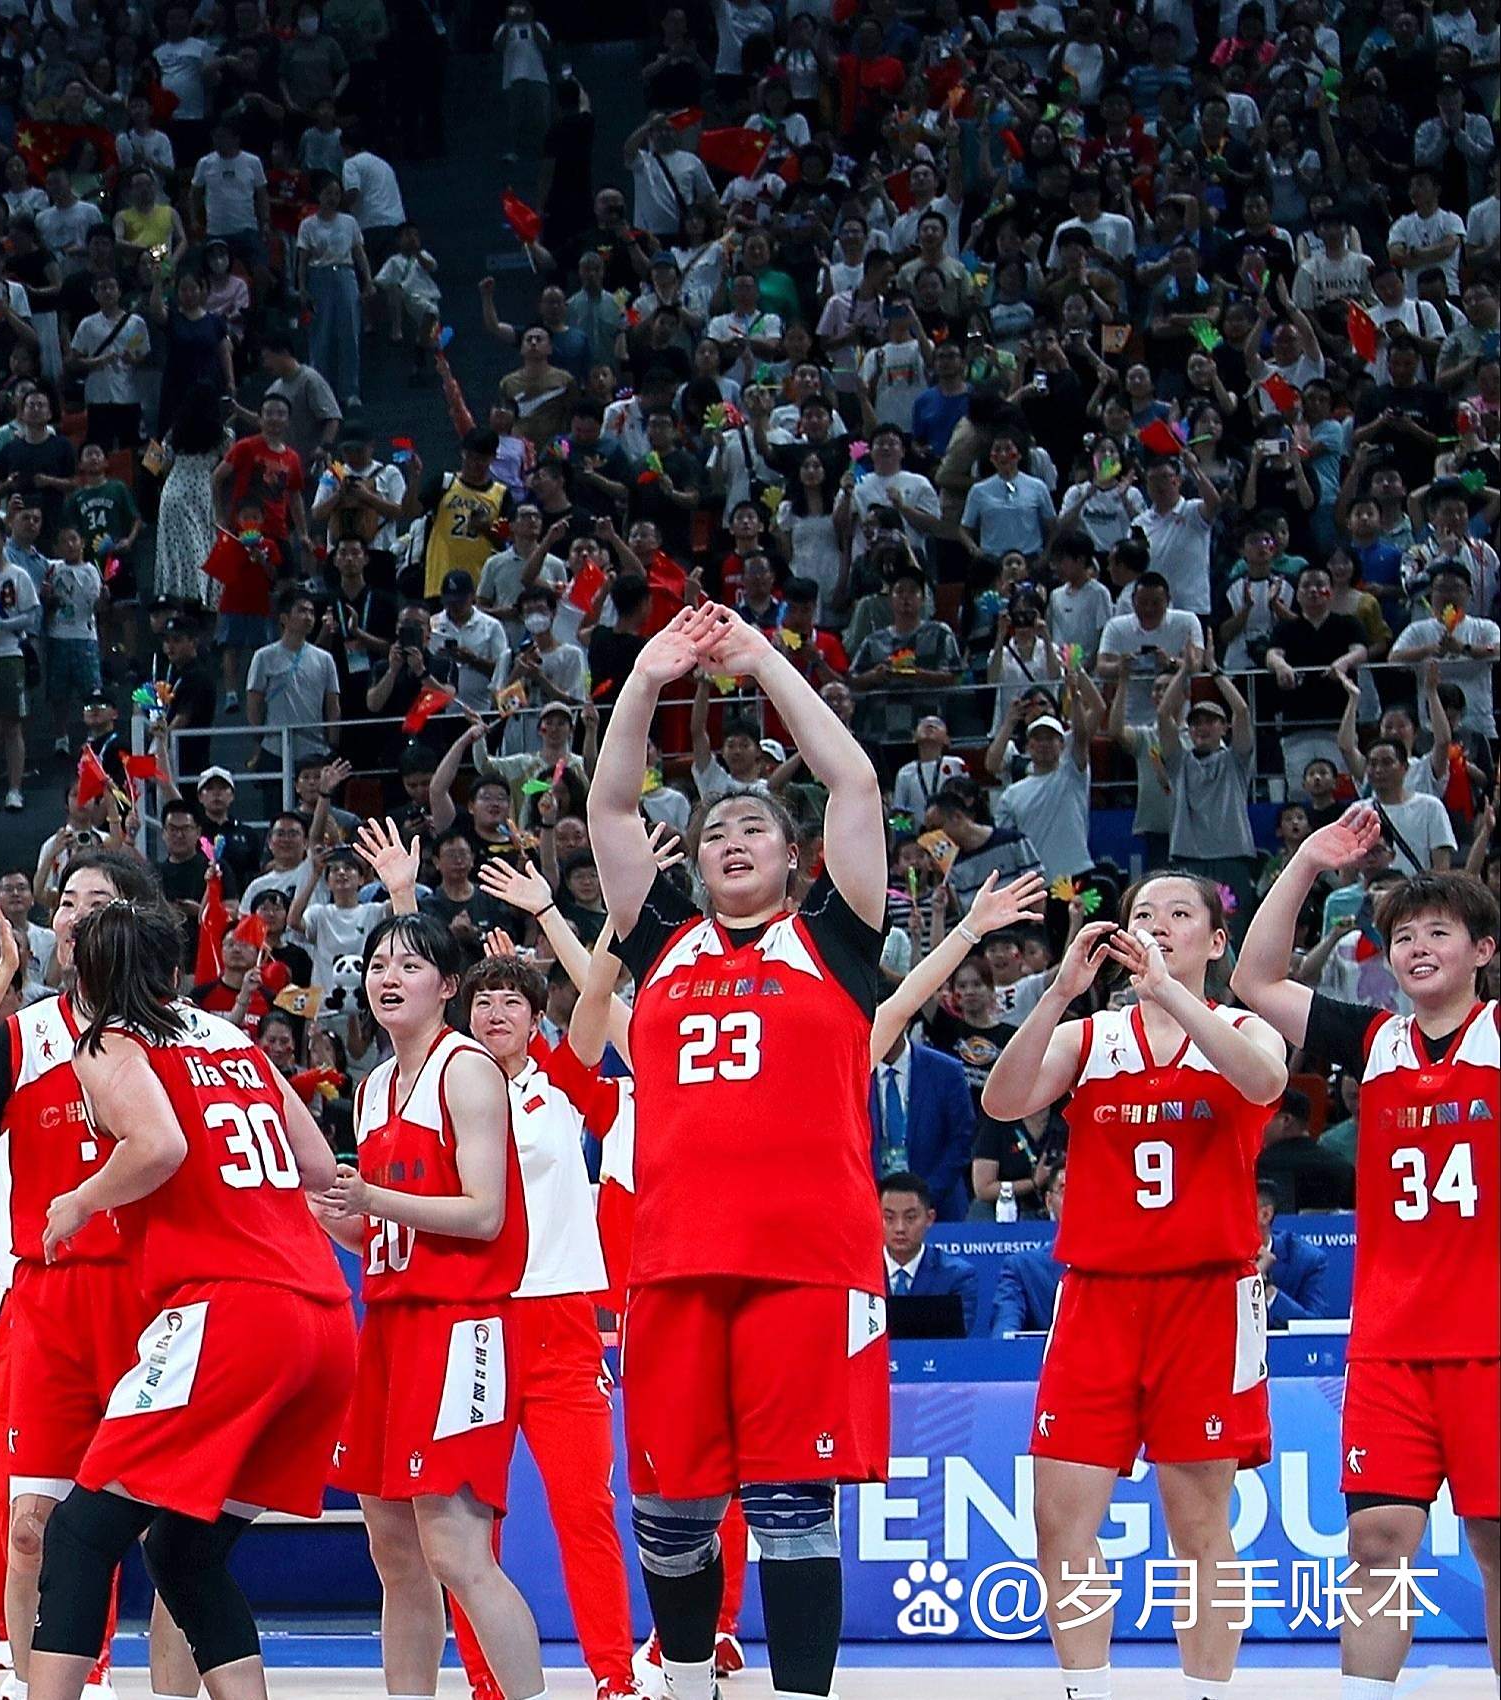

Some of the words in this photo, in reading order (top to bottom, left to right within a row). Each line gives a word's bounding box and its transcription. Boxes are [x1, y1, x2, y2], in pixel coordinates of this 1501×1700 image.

[668, 979, 785, 1000] CHINA
[184, 1056, 226, 1087] Jia
[678, 1011, 762, 1085] 23
[1094, 1100, 1212, 1124] CHINA
[203, 1102, 301, 1189] 30
[1134, 1140, 1173, 1209] 9
[1391, 1143, 1478, 1222] 34
[366, 1214, 416, 1275] 20
[963, 1240, 1041, 1255] UNIVERSITY
[470, 1323, 491, 1424] CHINA
